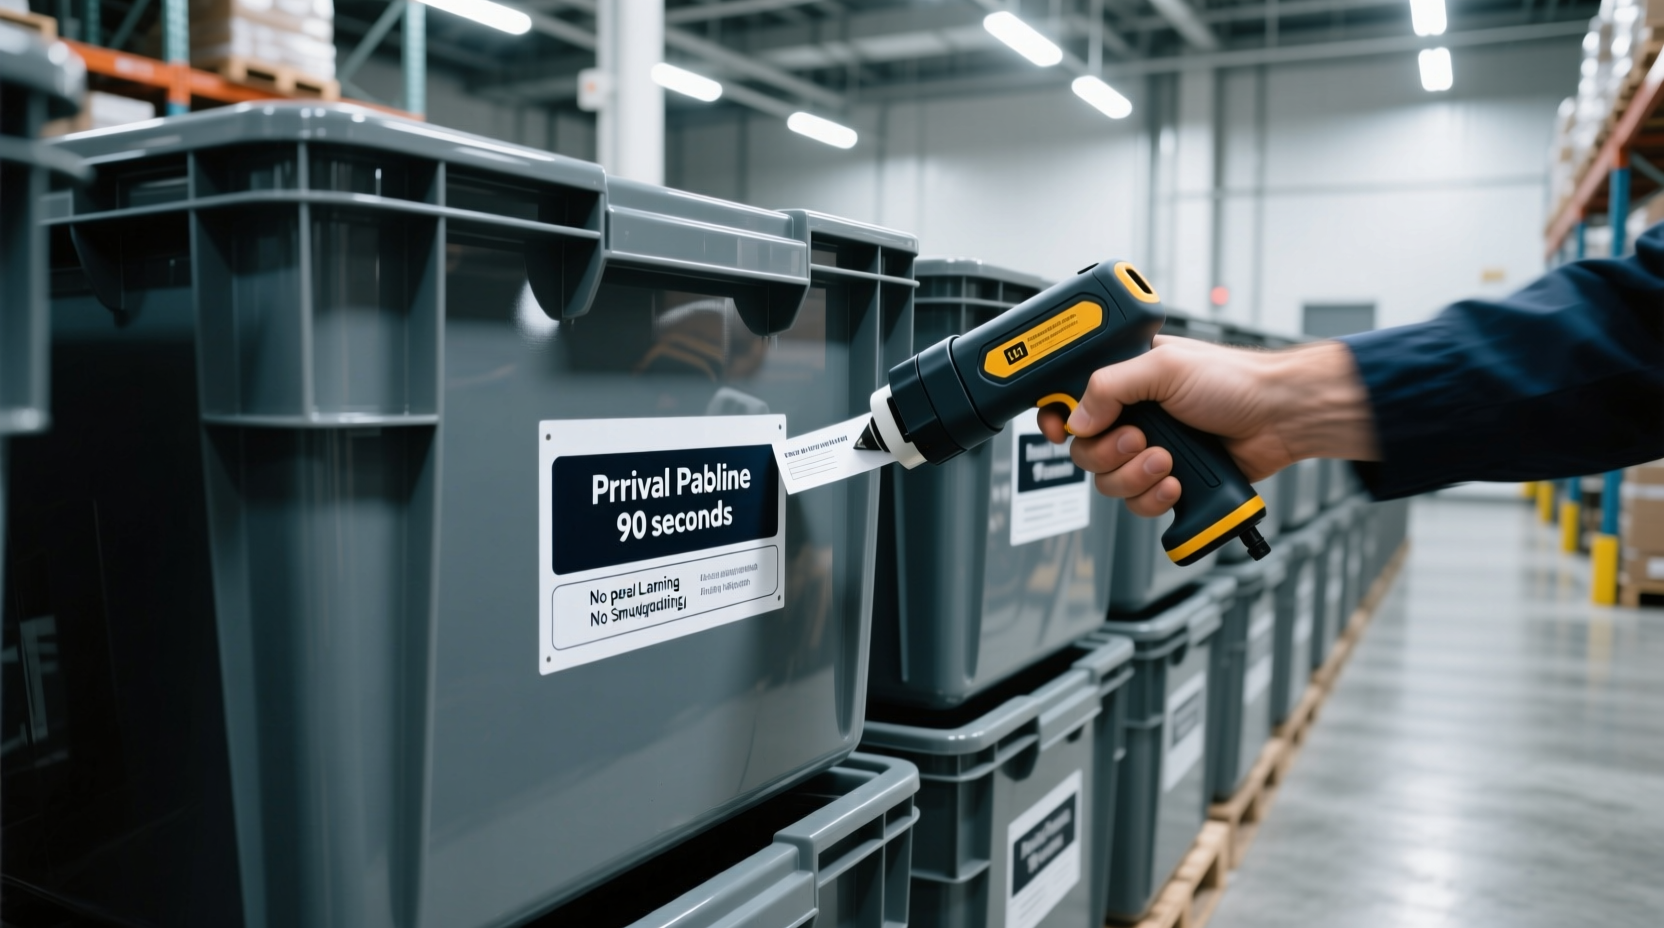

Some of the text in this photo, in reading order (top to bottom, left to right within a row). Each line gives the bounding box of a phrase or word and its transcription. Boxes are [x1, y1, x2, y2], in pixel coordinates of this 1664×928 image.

[592, 463, 751, 505] Prrival Pabline
[616, 499, 733, 542] 90 seconds
[590, 589, 607, 606] No
[590, 610, 608, 627] No
